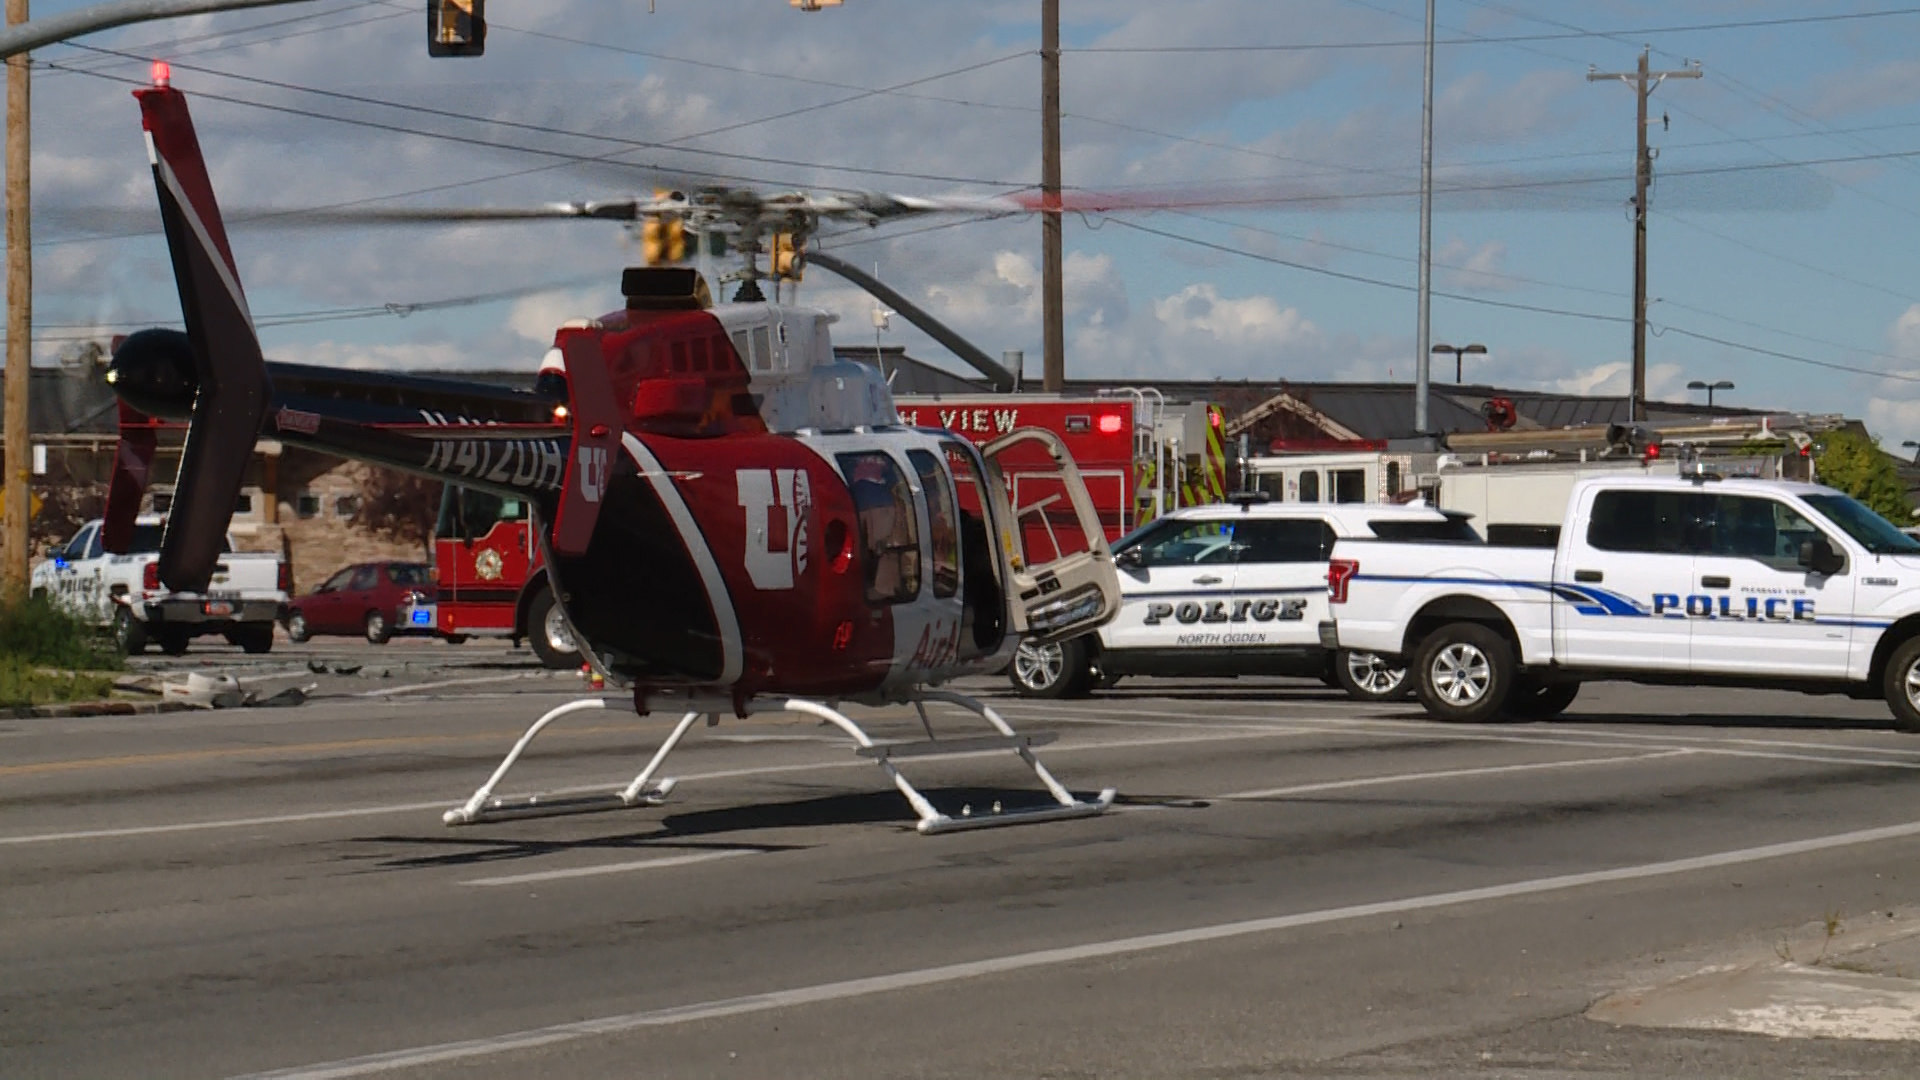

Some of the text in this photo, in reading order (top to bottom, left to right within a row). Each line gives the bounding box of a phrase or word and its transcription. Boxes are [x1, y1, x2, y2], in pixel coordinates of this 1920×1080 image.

[939, 408, 1018, 433] VIEW
[735, 468, 812, 590] U
[1142, 598, 1308, 626] POLICE
[1652, 592, 1815, 621] POLICE
[1176, 633, 1267, 645] NORTH OGDEN
